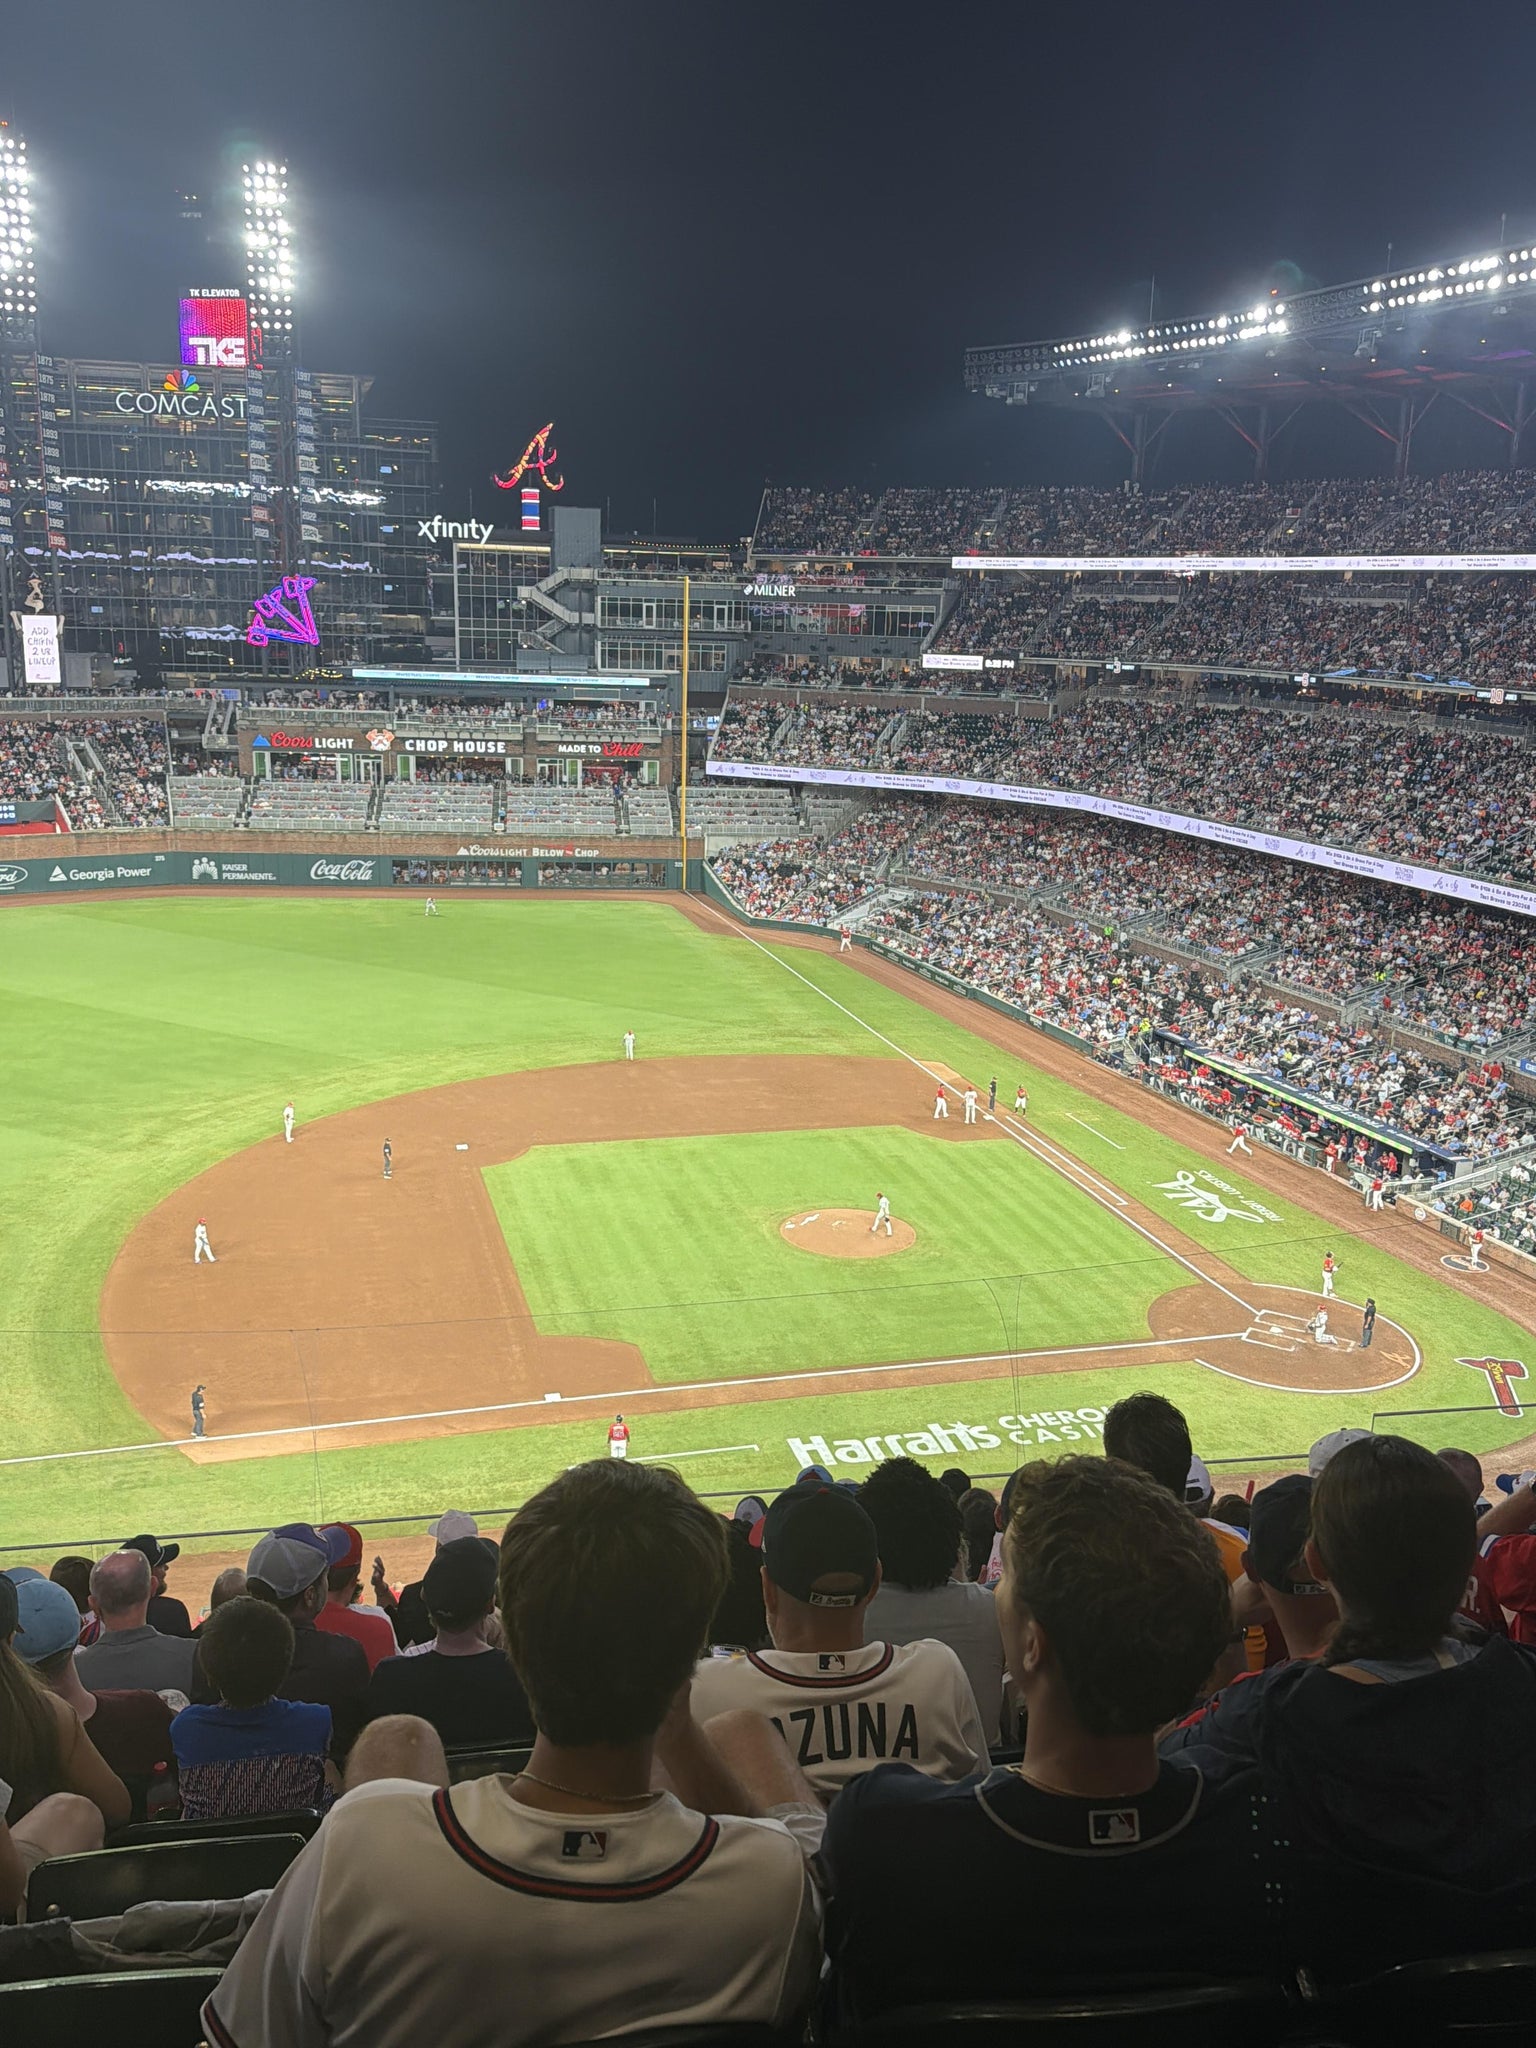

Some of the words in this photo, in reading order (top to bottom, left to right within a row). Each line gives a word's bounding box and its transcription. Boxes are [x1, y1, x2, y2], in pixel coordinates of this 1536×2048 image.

[189, 289, 200, 297] TK
[202, 289, 240, 297] ELEVATOR
[189, 337, 247, 365] TKE
[116, 391, 249, 418] COMCAST
[418, 515, 494, 544] xfinity
[754, 585, 796, 598] MILNER
[31, 627, 48, 636] ADD
[41, 648, 51, 656] UR
[29, 657, 55, 666] LINEUP
[1490, 688, 1504, 704] 10
[270, 731, 313, 749] Coors
[315, 737, 354, 749] LIGHT
[405, 739, 448, 751] CHOP
[453, 740, 506, 753] HOUSE
[558, 744, 586, 753] MADE
[588, 745, 601, 754] TO
[603, 742, 644, 757] Chill
[469, 844, 500, 857] Coors
[501, 848, 527, 857] LIGHT
[533, 847, 564, 857] BELOW
[574, 848, 599, 858] CHOP
[69, 867, 115, 881] Georgia
[117, 866, 152, 879] Power
[222, 863, 248, 872] KAISER
[310, 858, 377, 881] Coca-Cola
[770, 1702, 919, 1767] ZUNA
